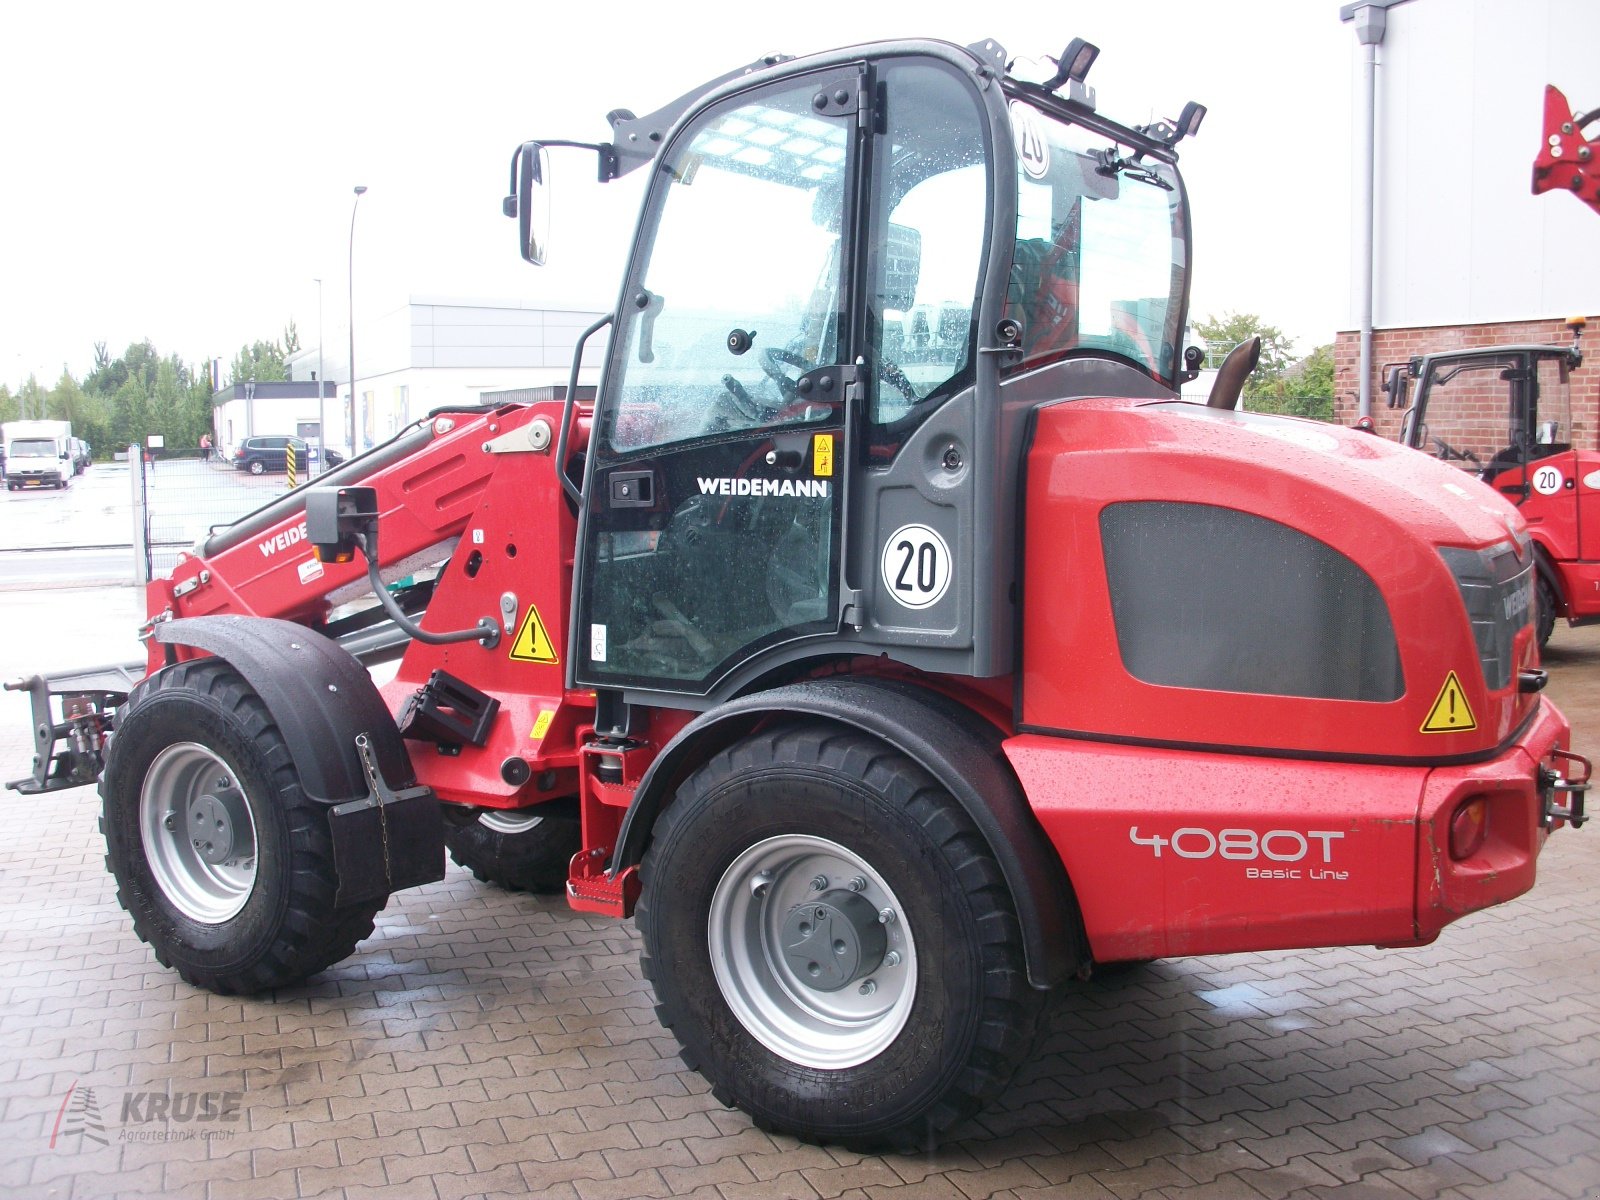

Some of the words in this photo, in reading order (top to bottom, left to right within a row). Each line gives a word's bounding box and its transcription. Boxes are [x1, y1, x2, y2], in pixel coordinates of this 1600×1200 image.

[697, 477, 827, 497] WEIDEMANN
[1540, 471, 1555, 489] 20
[895, 540, 937, 593] 20
[1129, 826, 1345, 863] 4080T
[1246, 867, 1302, 879] Basic
[1309, 868, 1349, 880] Line
